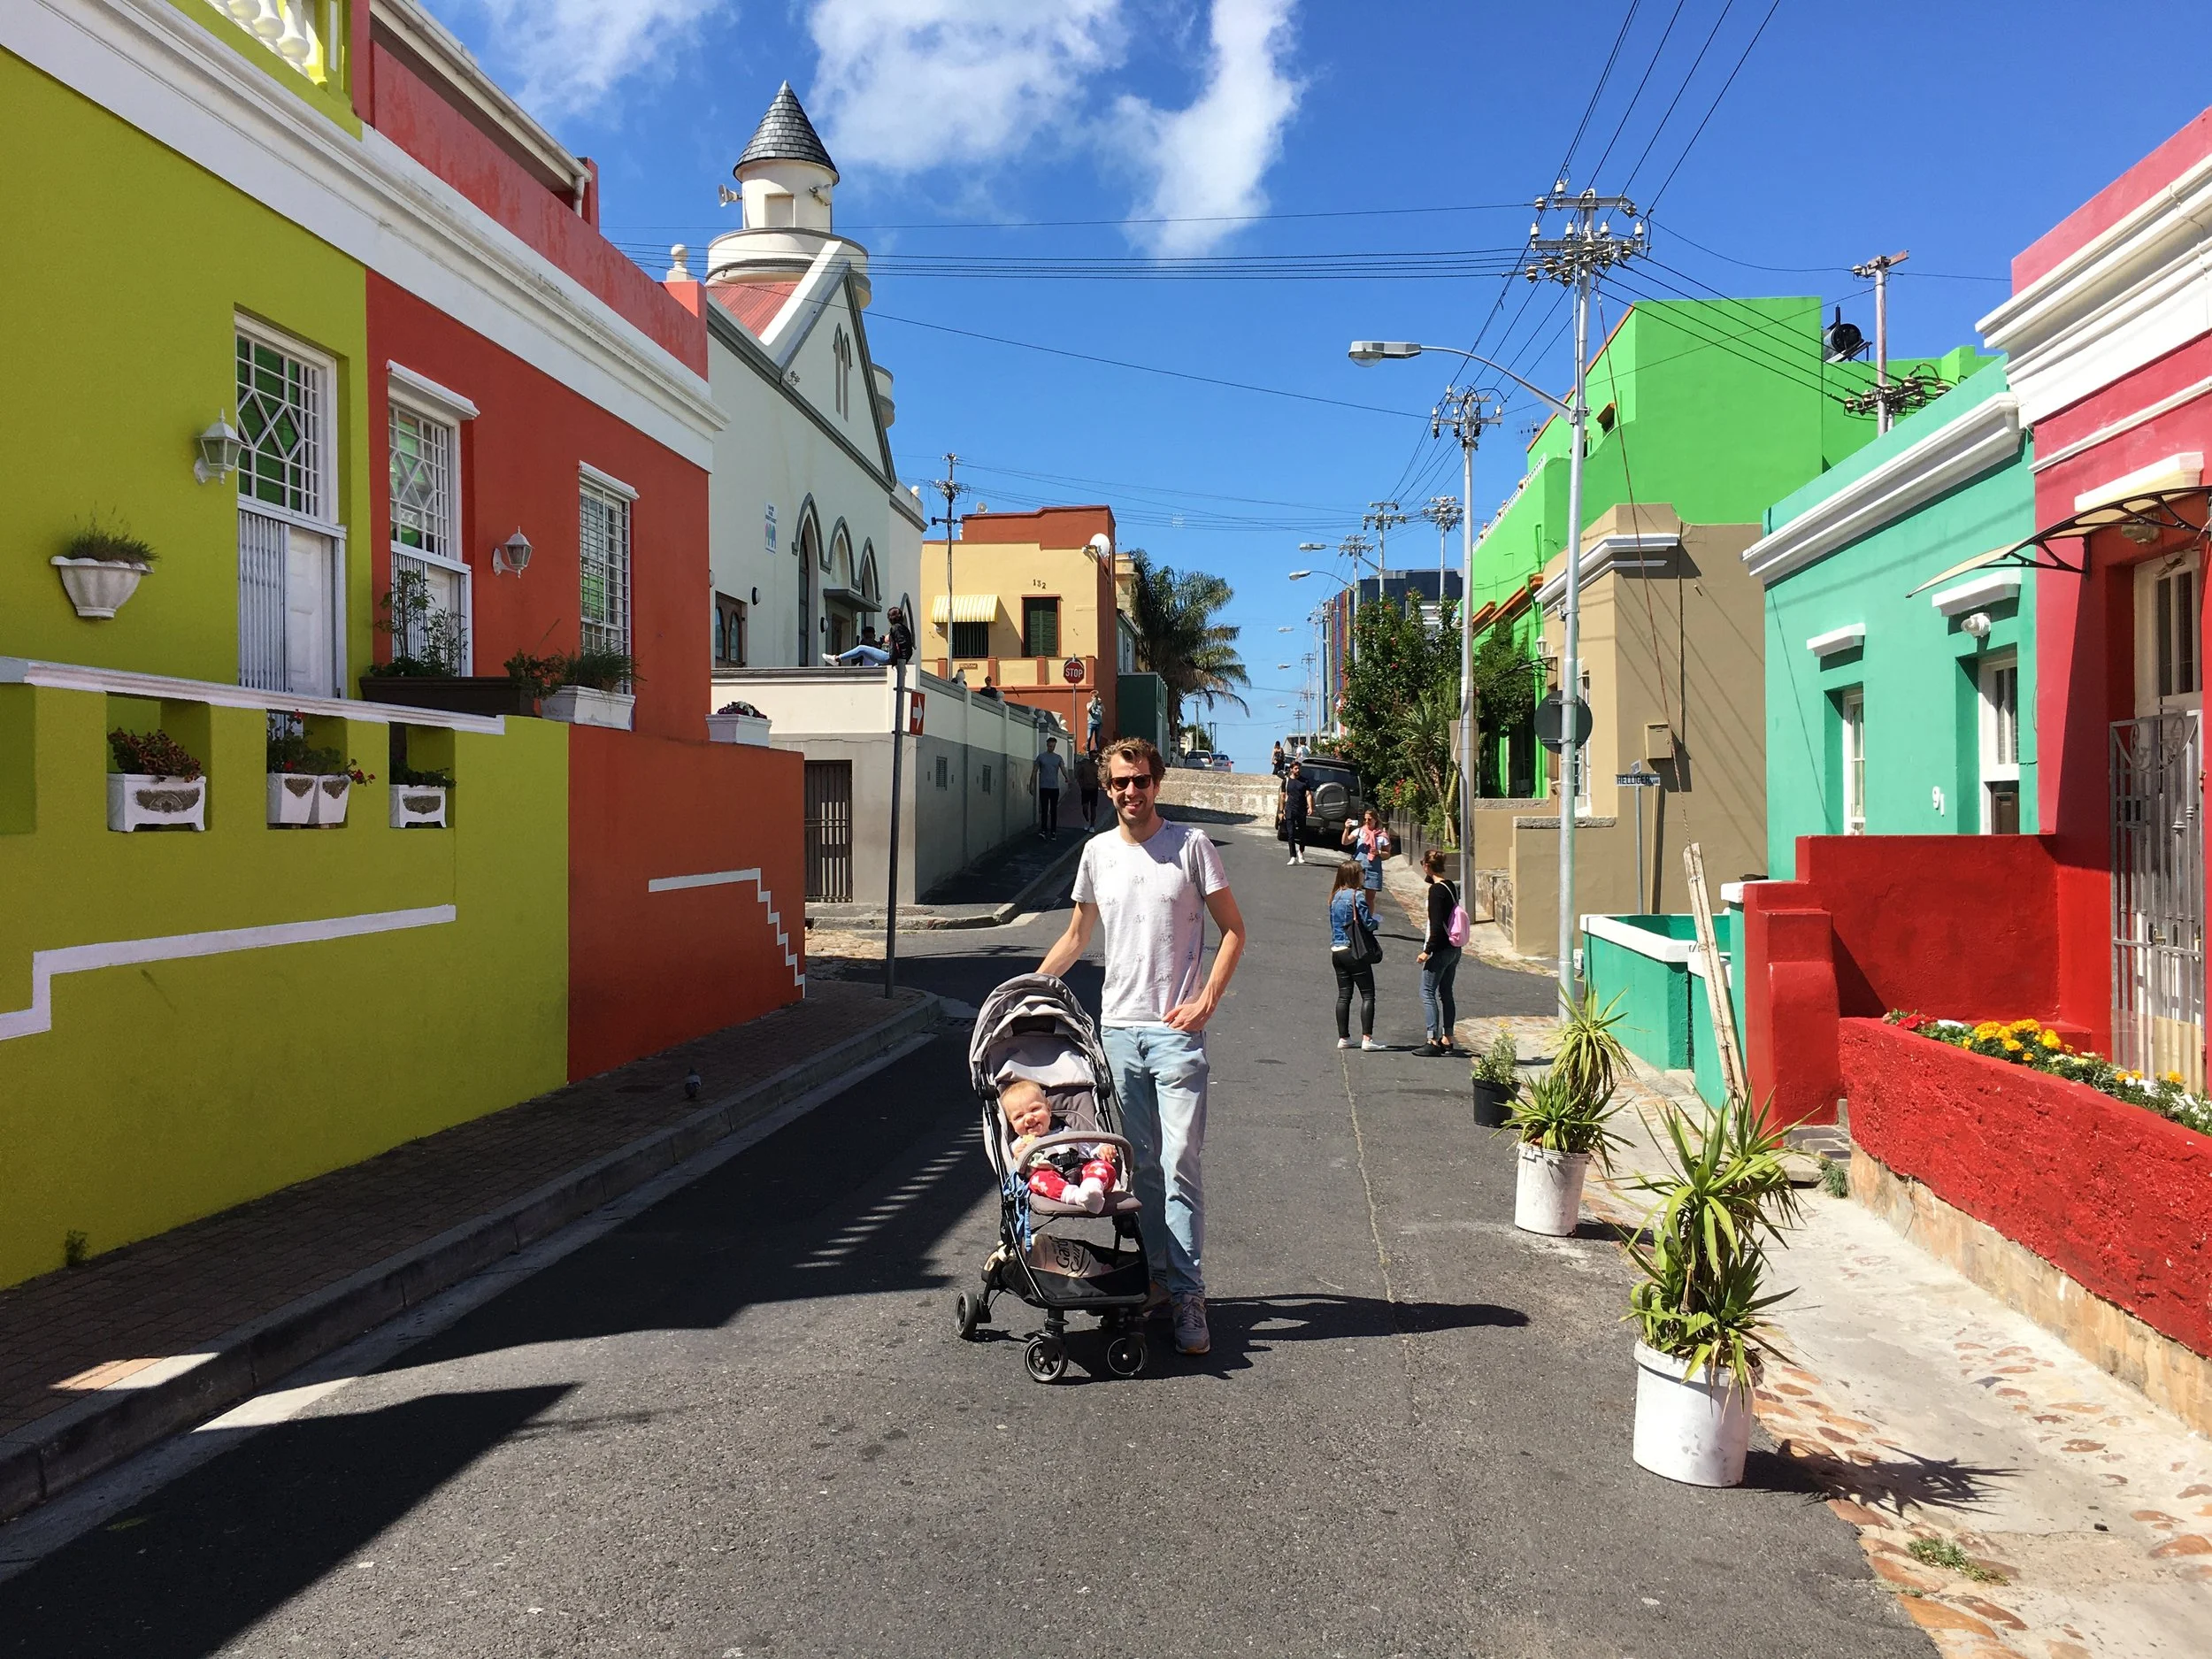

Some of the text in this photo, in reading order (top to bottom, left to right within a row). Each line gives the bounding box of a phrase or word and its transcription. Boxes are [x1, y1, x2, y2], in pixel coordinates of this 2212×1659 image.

[1033, 579, 1046, 589] 132
[1065, 668, 1083, 678] STOP
[1617, 775, 1651, 784] HELLIGER
